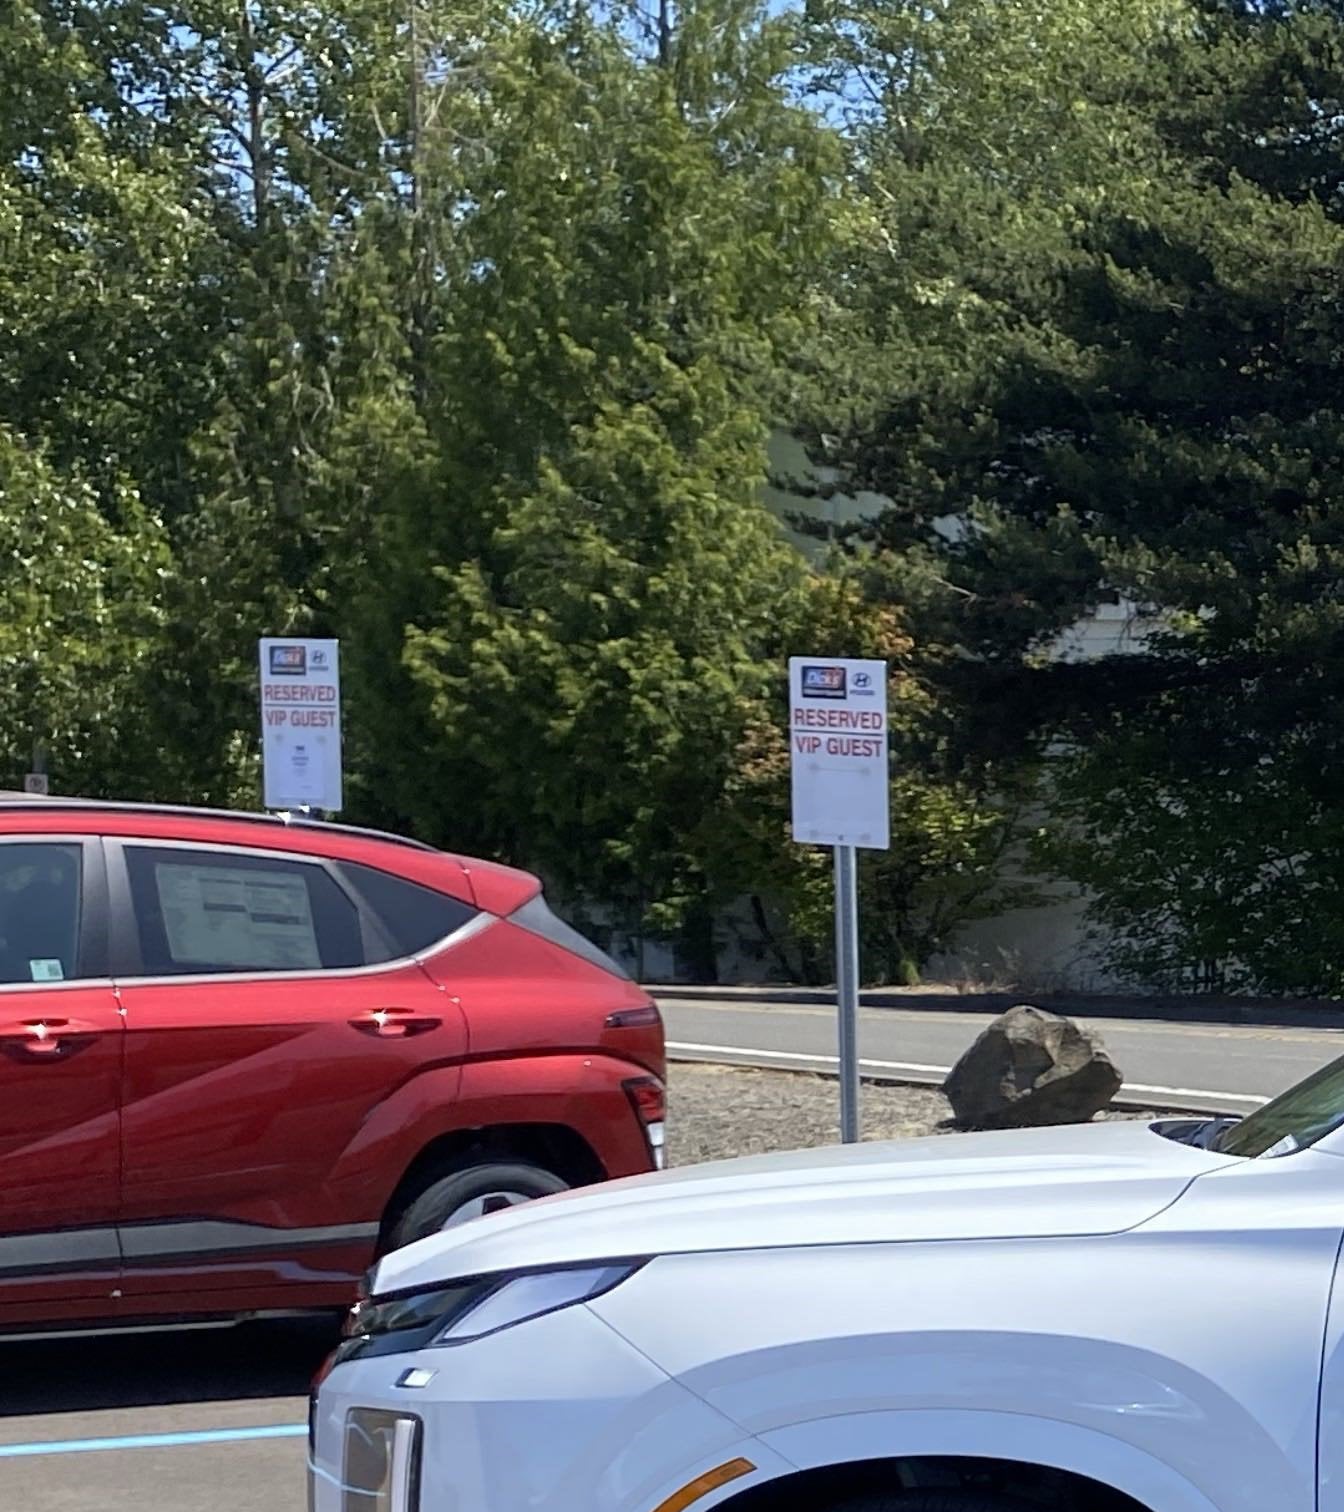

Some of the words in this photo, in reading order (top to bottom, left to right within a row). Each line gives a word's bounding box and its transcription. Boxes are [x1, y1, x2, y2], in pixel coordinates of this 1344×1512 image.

[264, 684, 336, 702] RESERVED
[265, 710, 287, 727] VIP
[290, 710, 336, 728] GUEST
[794, 708, 883, 730] RESERVED
[795, 736, 821, 753] VIP
[827, 738, 883, 757] GUEST
